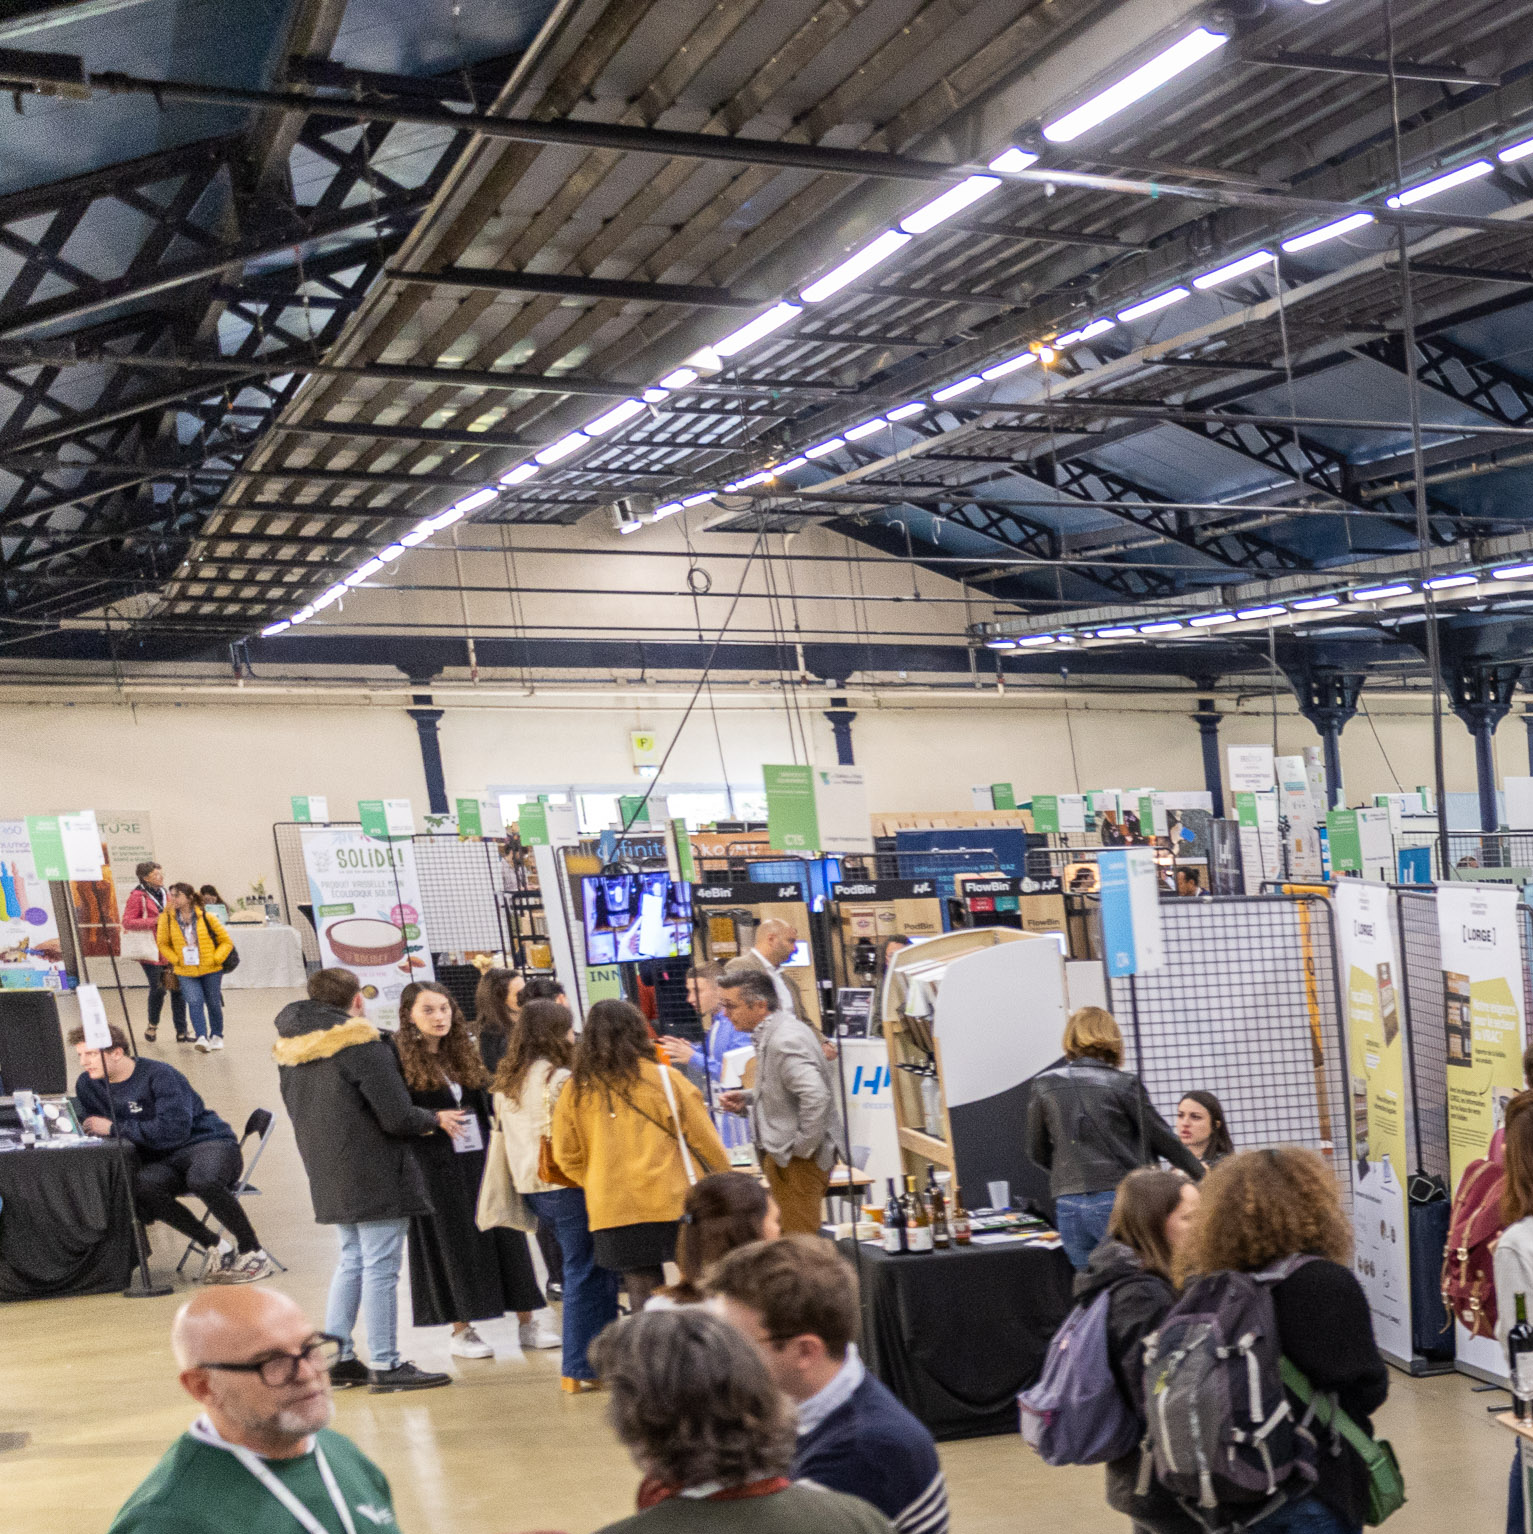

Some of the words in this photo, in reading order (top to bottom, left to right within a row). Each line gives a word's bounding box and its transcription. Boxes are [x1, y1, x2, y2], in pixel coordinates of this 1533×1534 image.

[834, 884, 876, 896] PodBin
[965, 881, 1011, 892] FlowBin
[904, 921, 935, 931] PodBin
